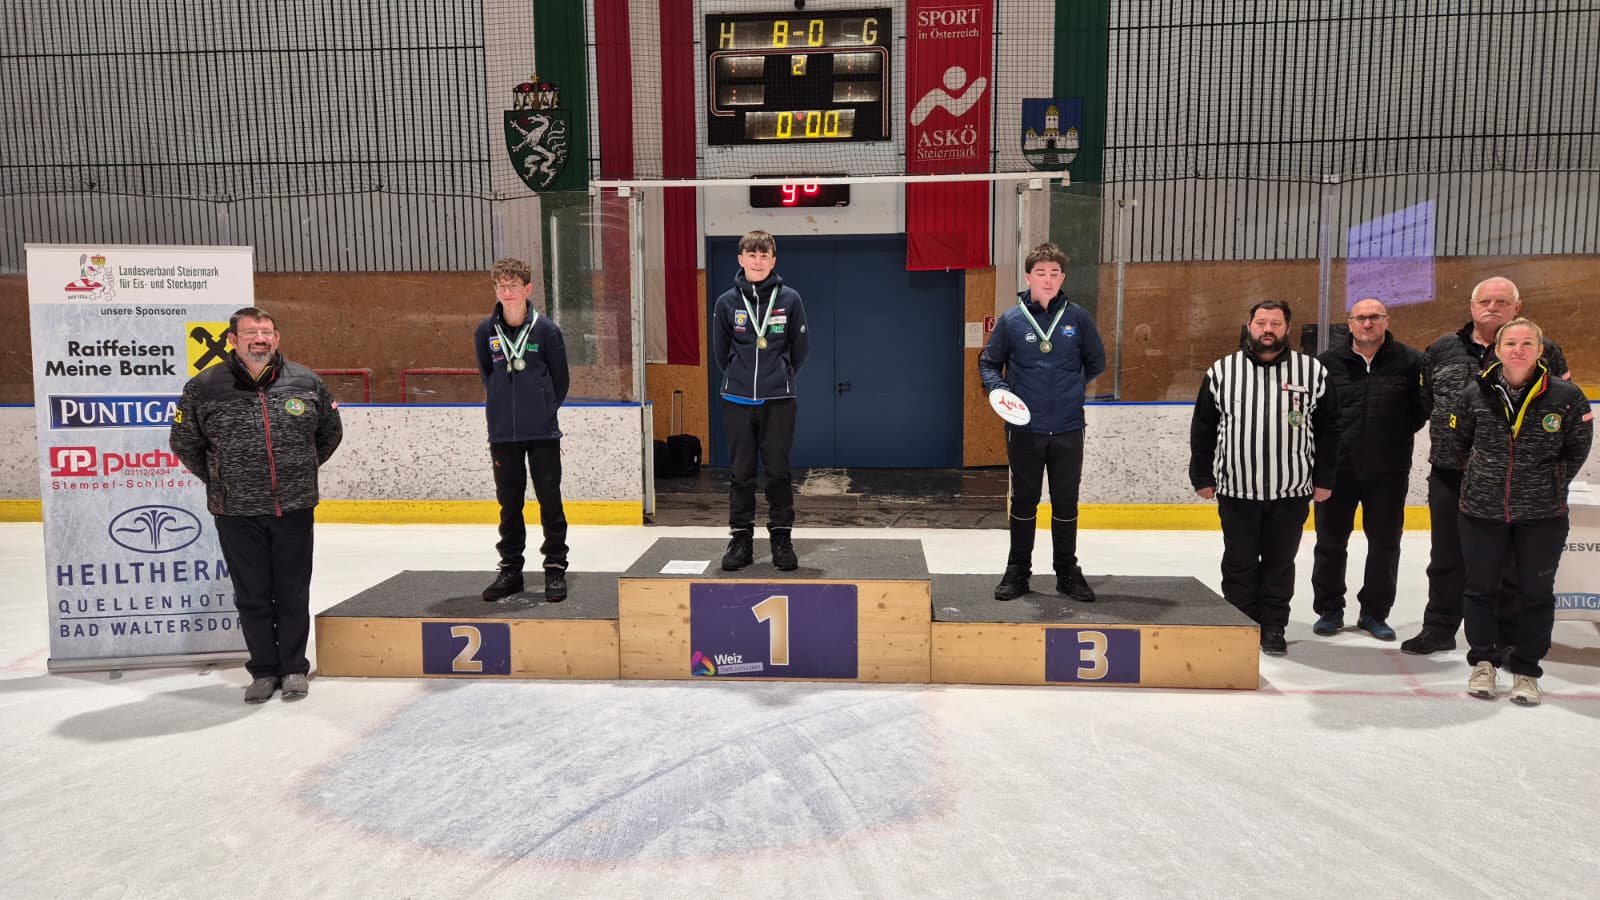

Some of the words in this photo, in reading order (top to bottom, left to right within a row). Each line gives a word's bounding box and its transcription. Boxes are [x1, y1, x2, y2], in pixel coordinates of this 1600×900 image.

[918, 8, 980, 27] SPORT
[719, 22, 735, 49] H
[862, 18, 878, 45] G
[918, 30, 928, 39] in
[930, 28, 979, 39] Österreich
[792, 56, 805, 75] 2
[917, 124, 977, 147] ASKÖ
[917, 145, 977, 159] Steiermark
[119, 265, 175, 277] Landesverband
[177, 266, 219, 277] Steiermark
[119, 278, 131, 289] für
[133, 279, 148, 289] Eis-
[150, 279, 164, 289] und
[166, 279, 208, 290] Stocksport
[101, 308, 133, 316] unsere
[135, 306, 187, 317] Sponsoren
[68, 340, 175, 357] Raiffeisen
[45, 361, 112, 377] Meine
[120, 359, 176, 376] Bank
[60, 399, 177, 425] PUNTIGA
[57, 560, 230, 586] HEILTHERM
[60, 623, 99, 637] BAD
[751, 595, 789, 666] 1
[451, 625, 482, 672] 2
[1077, 631, 1109, 680] 3
[714, 652, 743, 665] Weiz
